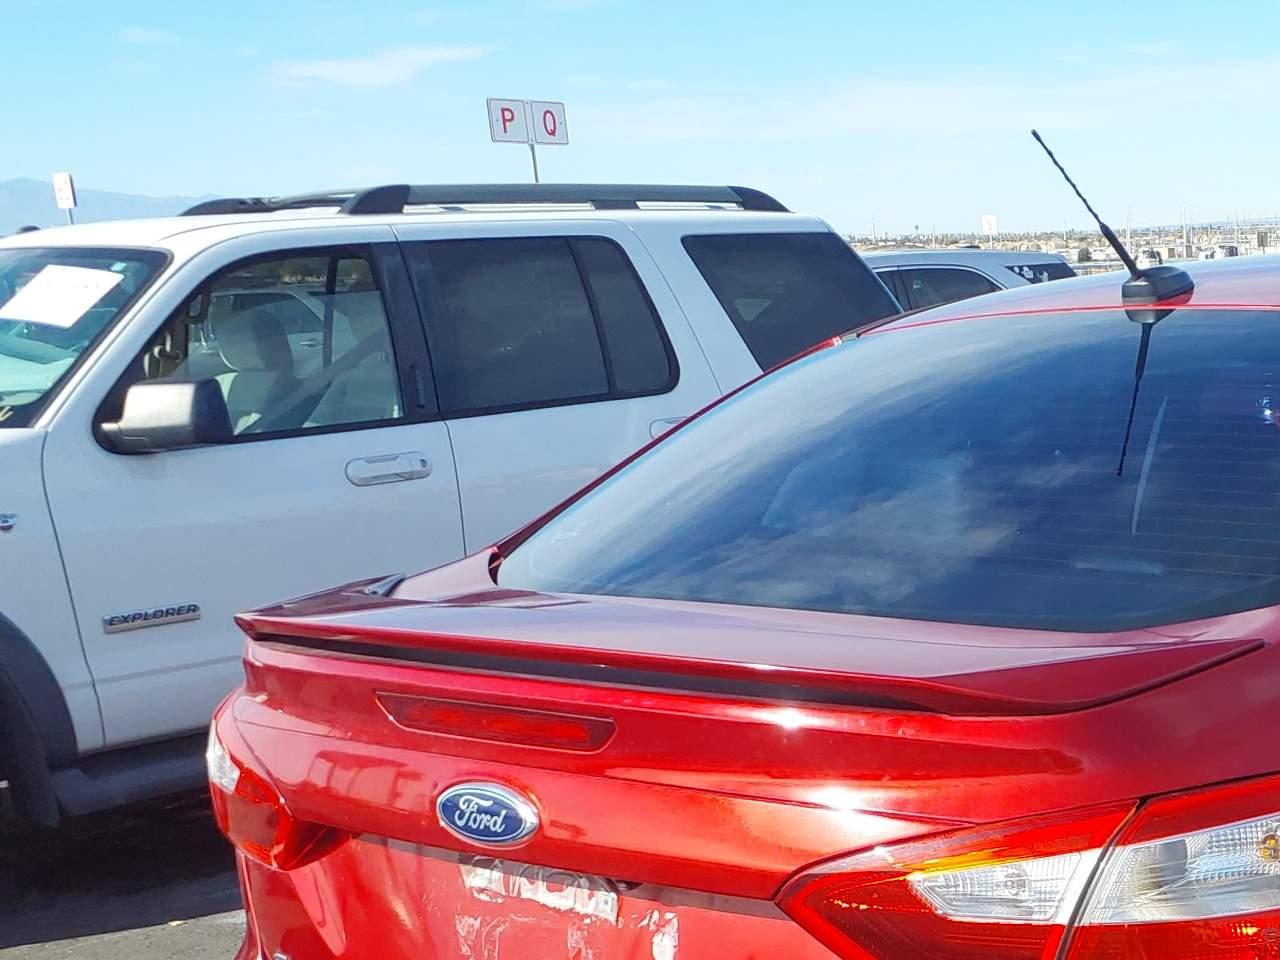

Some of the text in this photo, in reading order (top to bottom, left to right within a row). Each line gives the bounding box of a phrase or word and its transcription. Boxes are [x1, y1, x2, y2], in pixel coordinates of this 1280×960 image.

[501, 107, 515, 134] P
[543, 109, 557, 137] Q
[106, 603, 200, 626] EXPLORER
[454, 795, 508, 833] Ford
